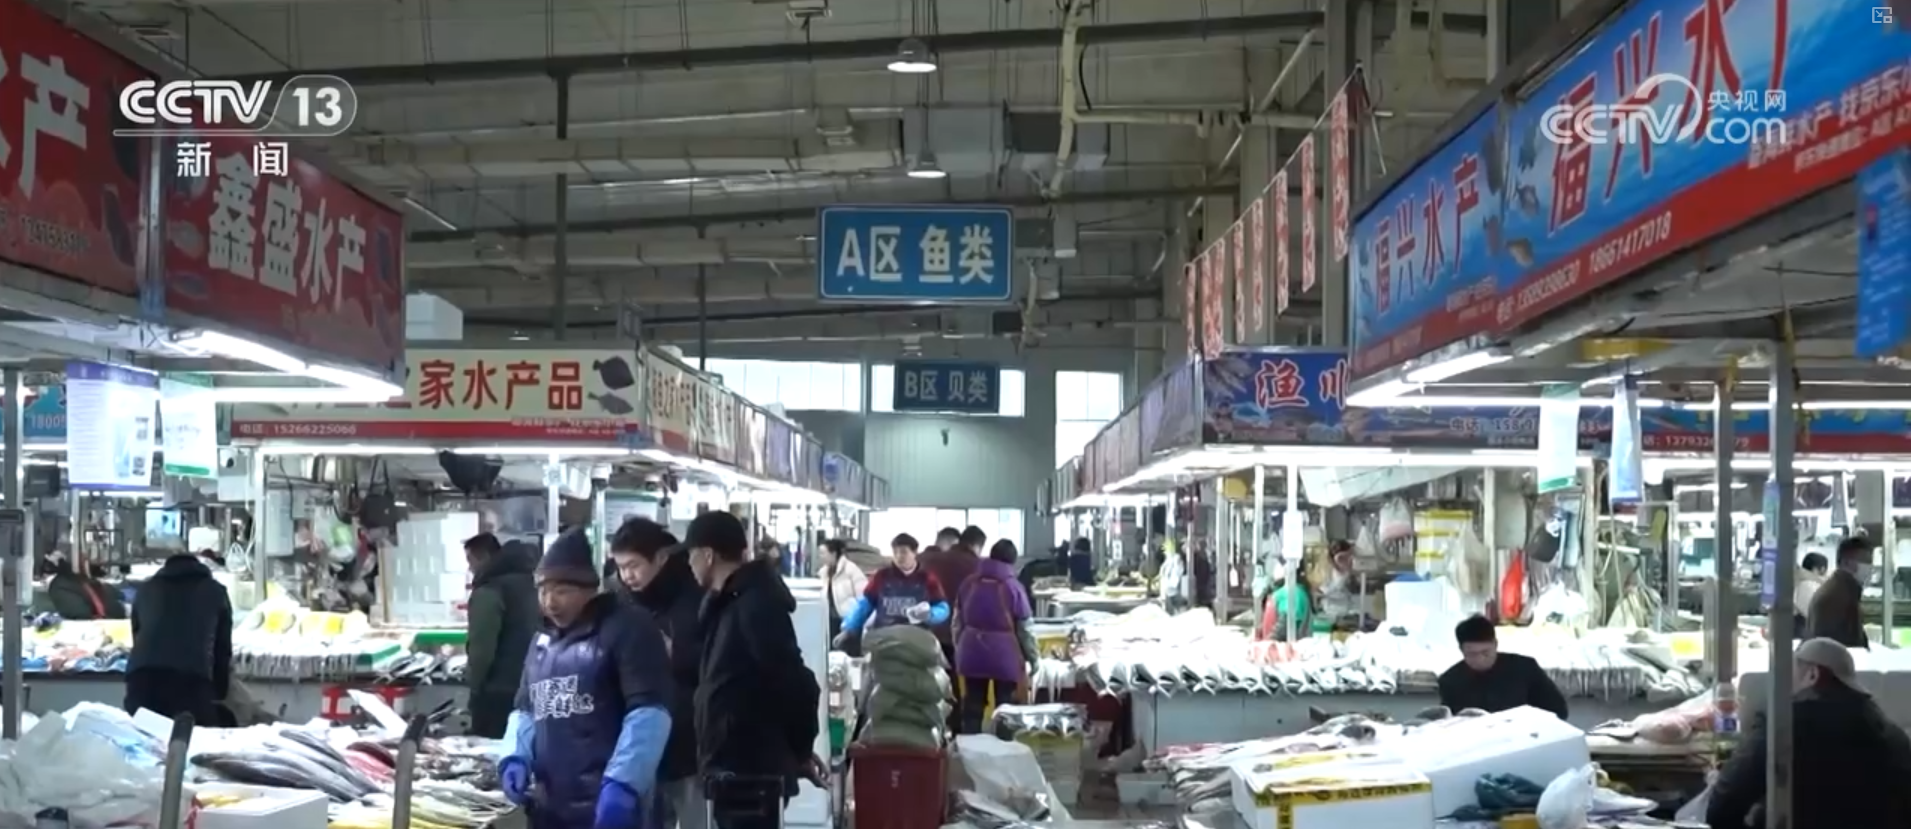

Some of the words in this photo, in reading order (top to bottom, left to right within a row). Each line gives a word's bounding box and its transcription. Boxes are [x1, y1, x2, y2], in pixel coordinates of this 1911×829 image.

[0, 50, 91, 201] 产
[1547, 0, 1790, 238] 福兴水
[208, 151, 367, 315] 鑫盛水产
[837, 226, 902, 282] A区
[919, 224, 995, 284] 鱼类
[376, 358, 582, 410] 家水产品
[904, 370, 938, 401] B区
[948, 370, 987, 403] 贝类
